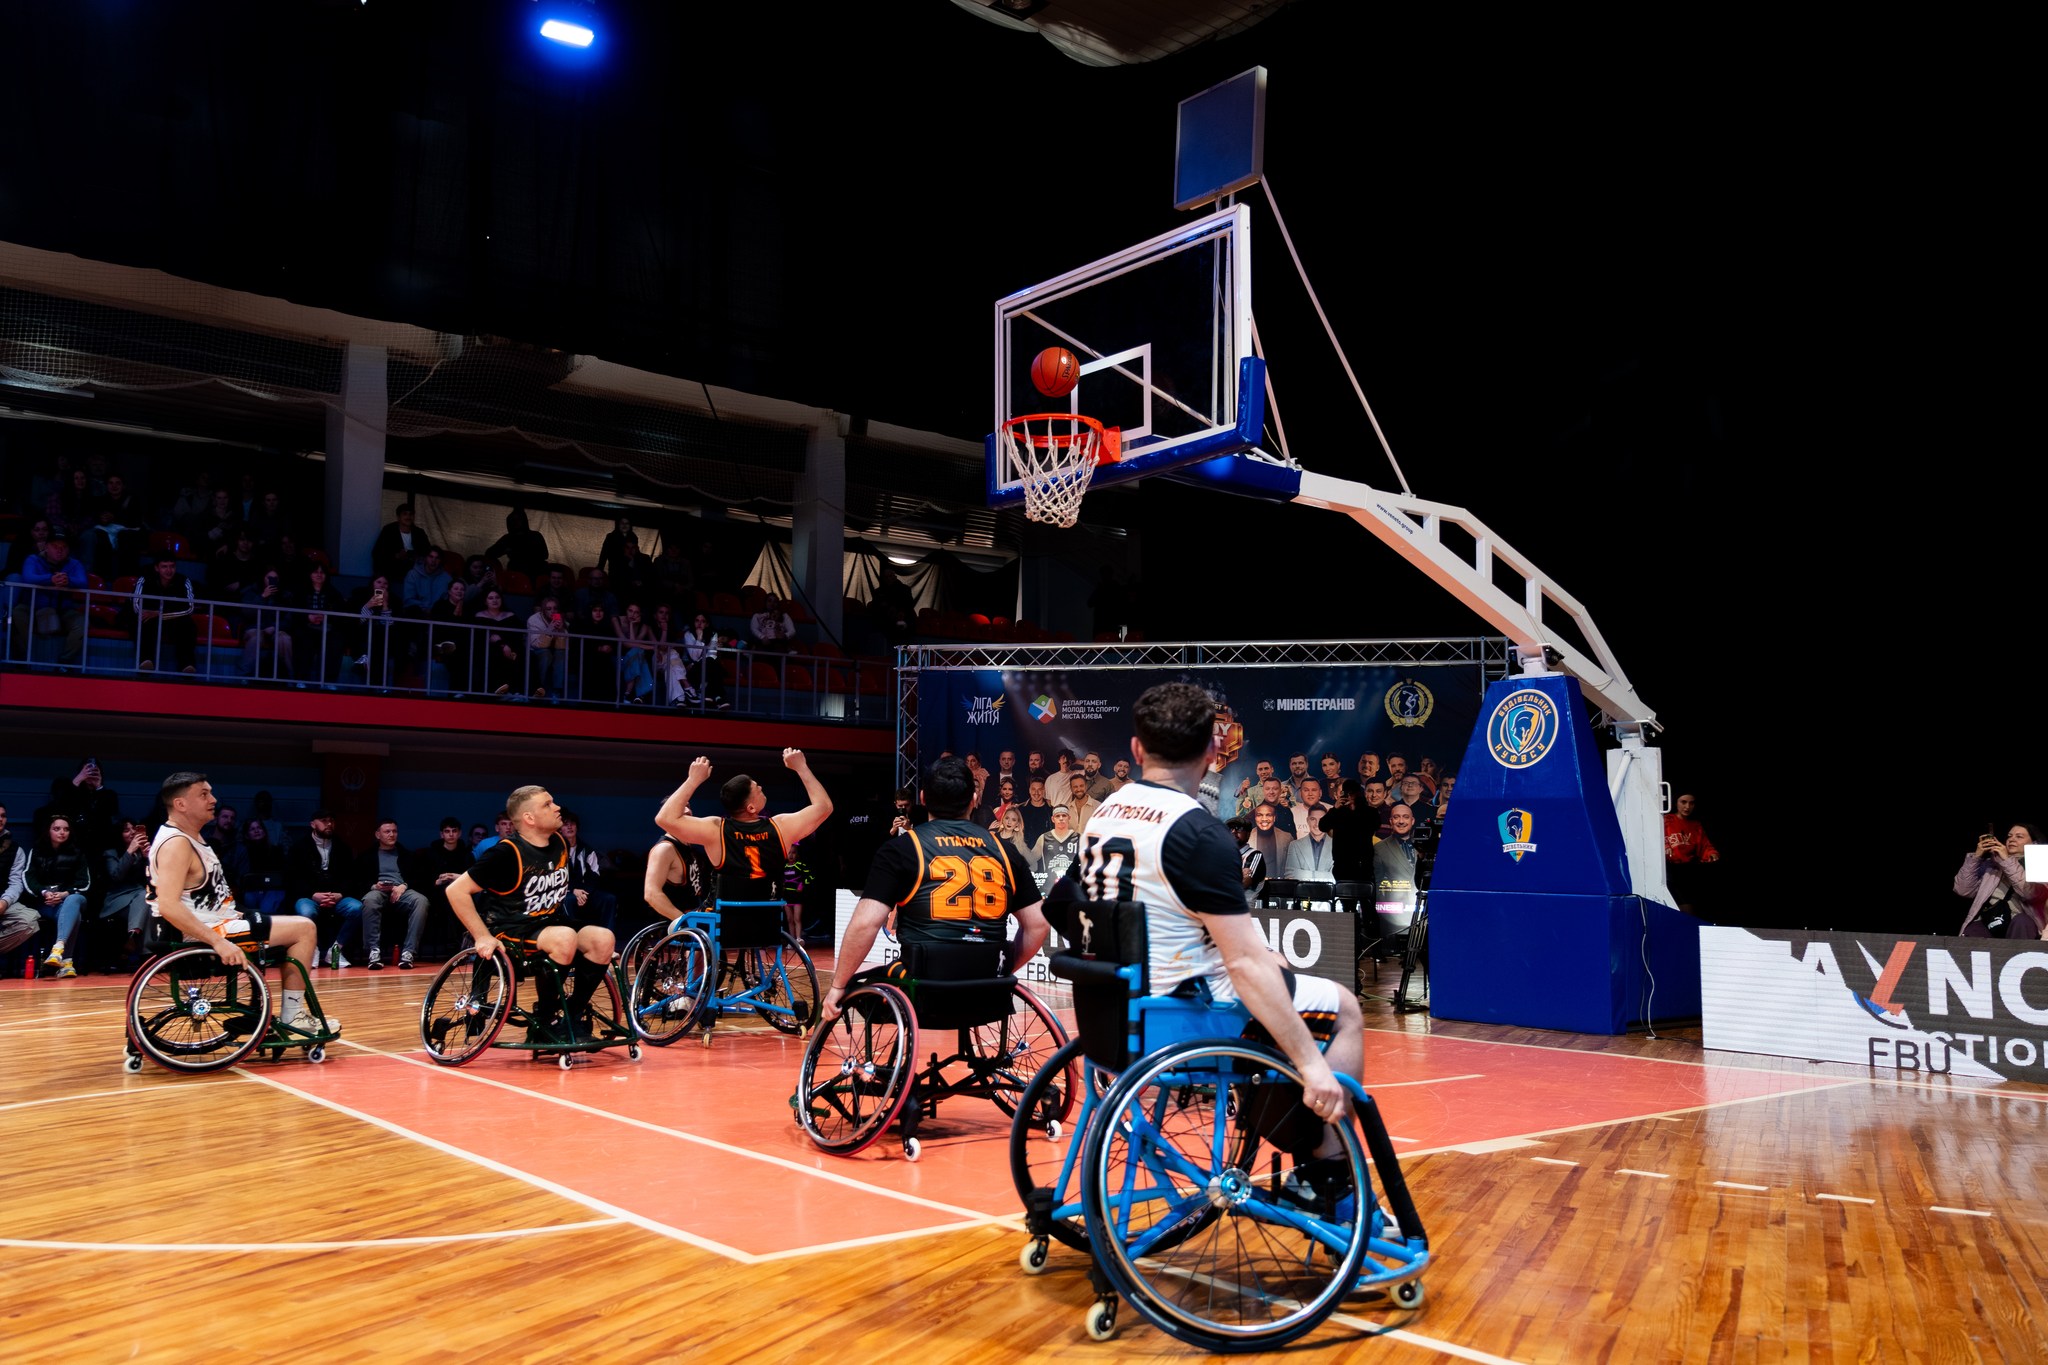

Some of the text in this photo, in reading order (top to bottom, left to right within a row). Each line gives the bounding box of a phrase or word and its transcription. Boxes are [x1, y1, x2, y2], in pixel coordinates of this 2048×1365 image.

[972, 696, 993, 711] ЛІГА
[1061, 706, 1086, 714] МОЛОДІ
[1096, 706, 1120, 714] СПОРТУ
[1276, 698, 1356, 711] МІНВЕТЕРАНІВ
[1498, 694, 1552, 717] БУДІВЕЛЬНИК
[734, 831, 769, 841] TYANOVI
[1067, 842, 1078, 854] 91
[744, 845, 767, 879] 1
[928, 855, 1008, 920] 28
